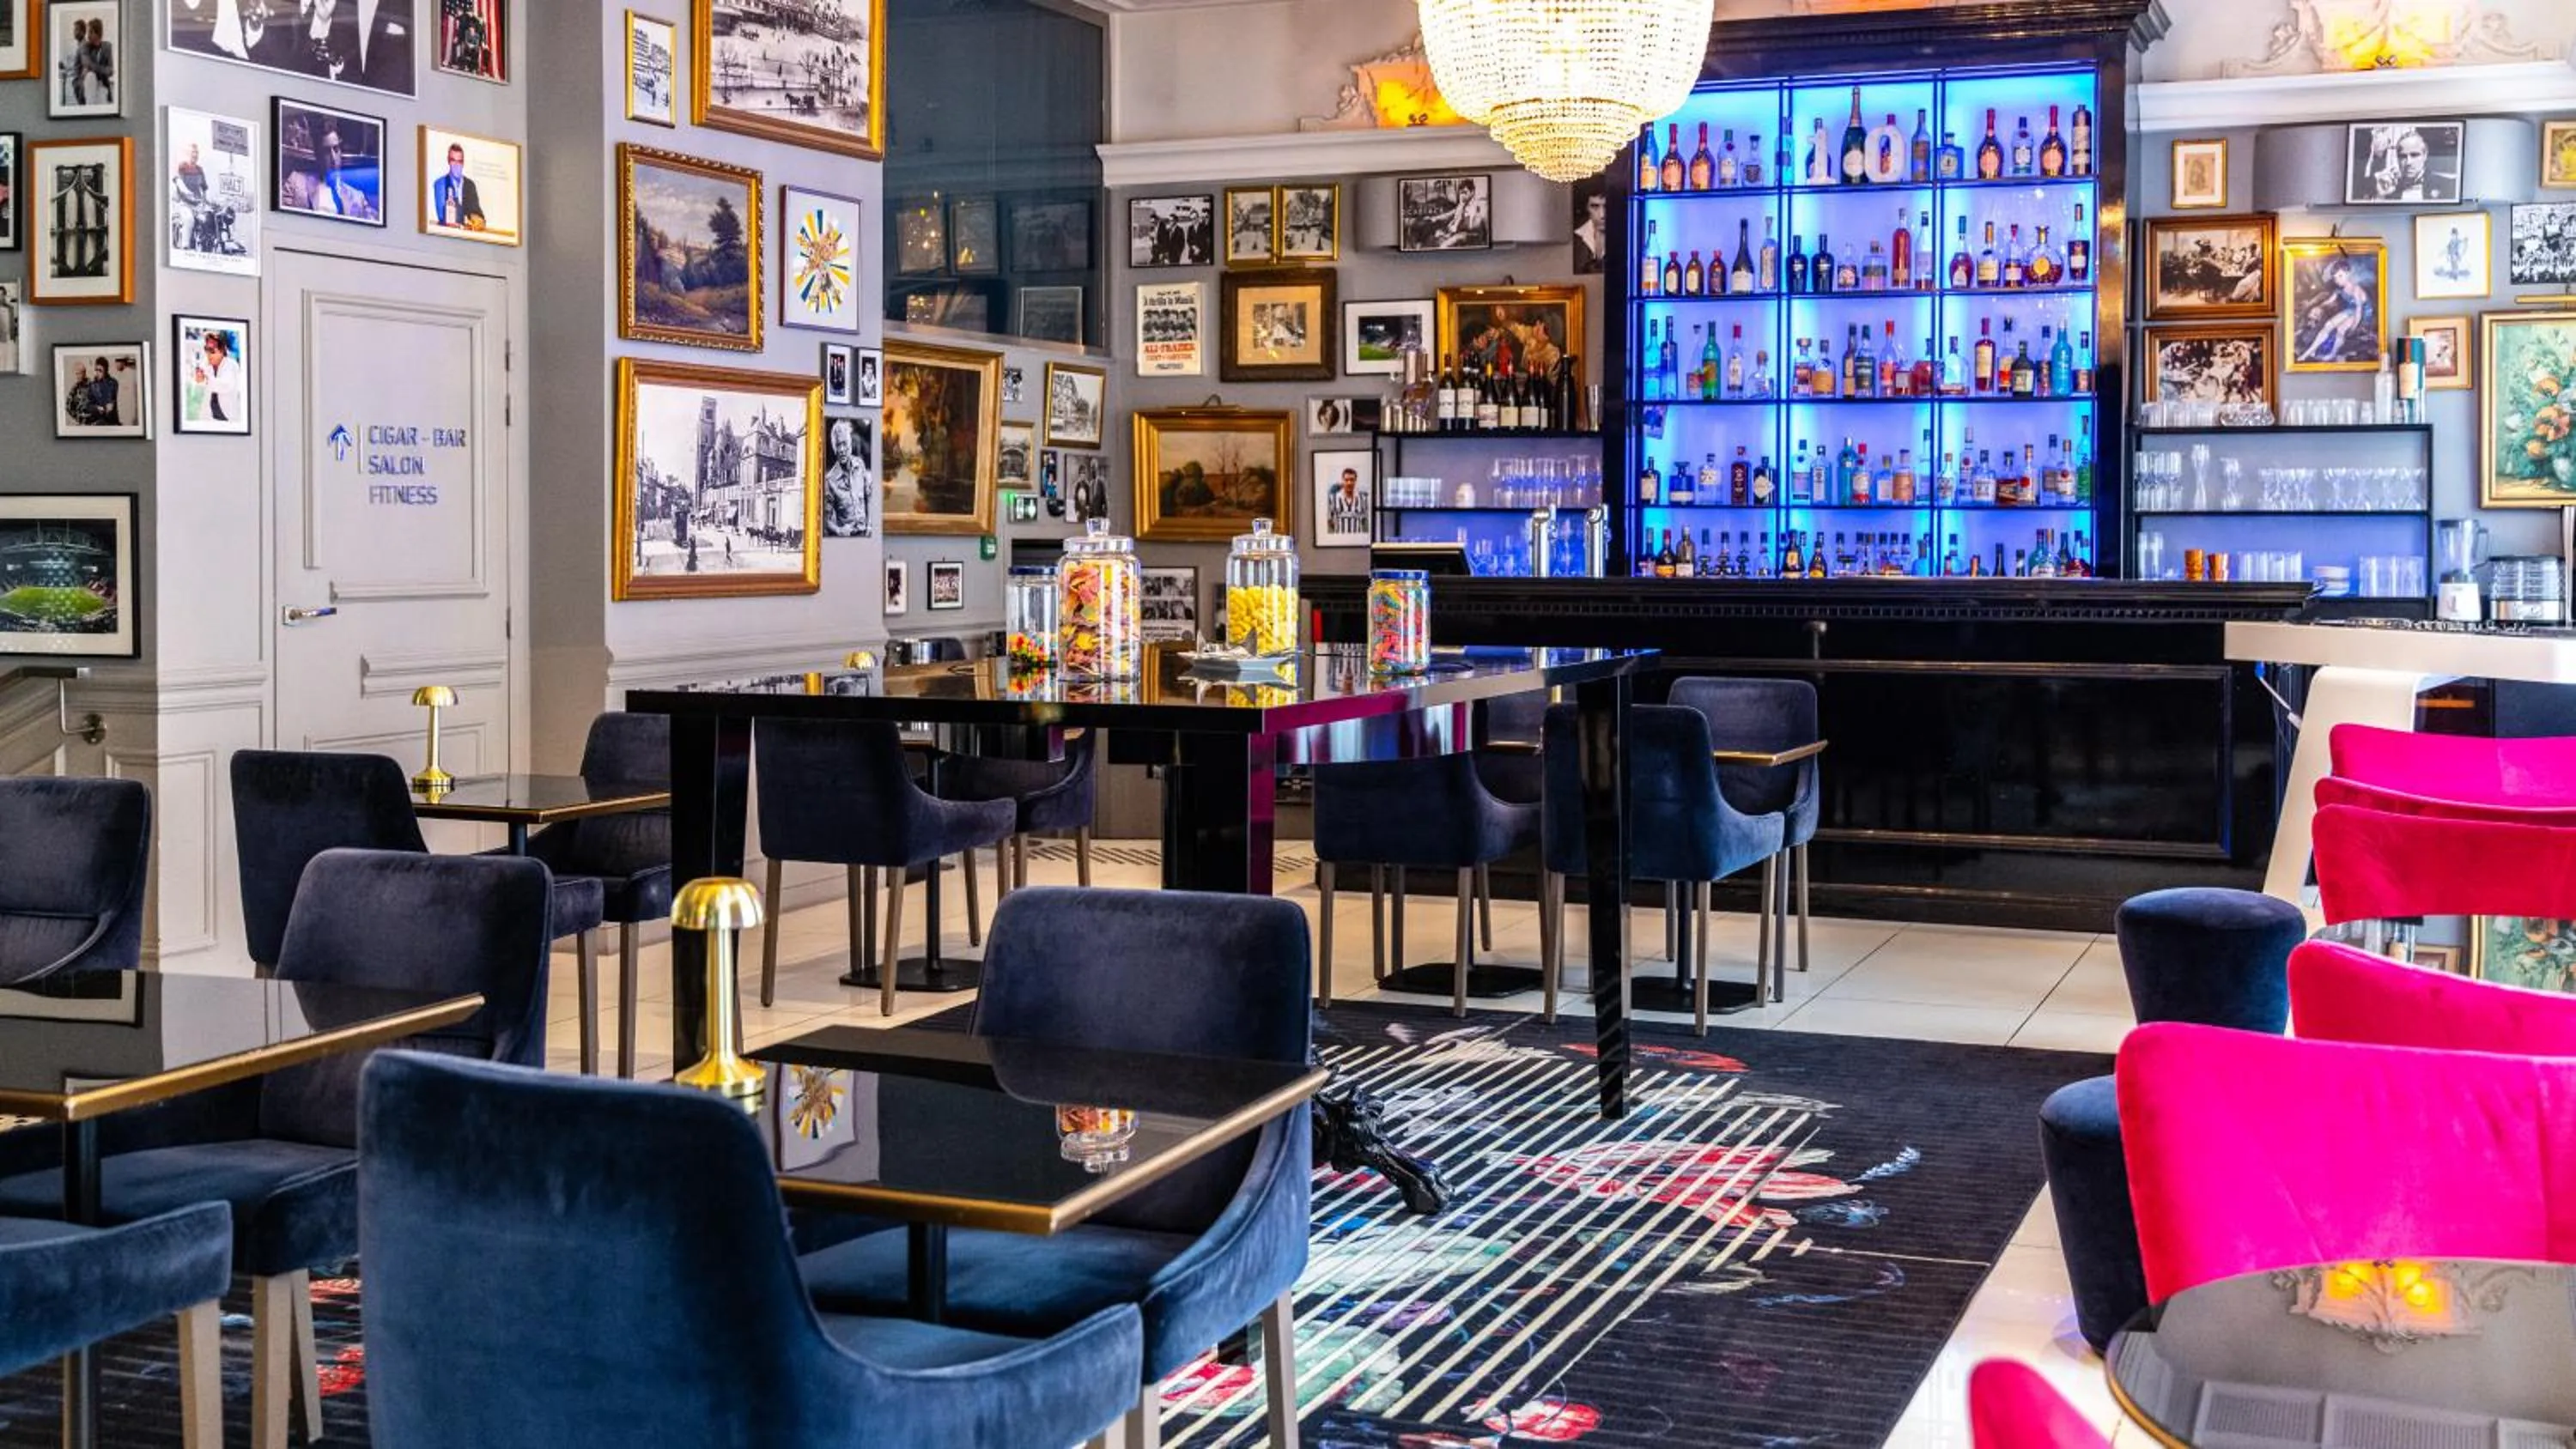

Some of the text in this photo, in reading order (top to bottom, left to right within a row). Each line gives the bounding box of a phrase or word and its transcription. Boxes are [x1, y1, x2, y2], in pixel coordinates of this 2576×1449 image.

[368, 425, 418, 446] CIGAR
[432, 427, 466, 447] BAR
[368, 455, 425, 475] SALON
[368, 484, 438, 505] FITNESS
